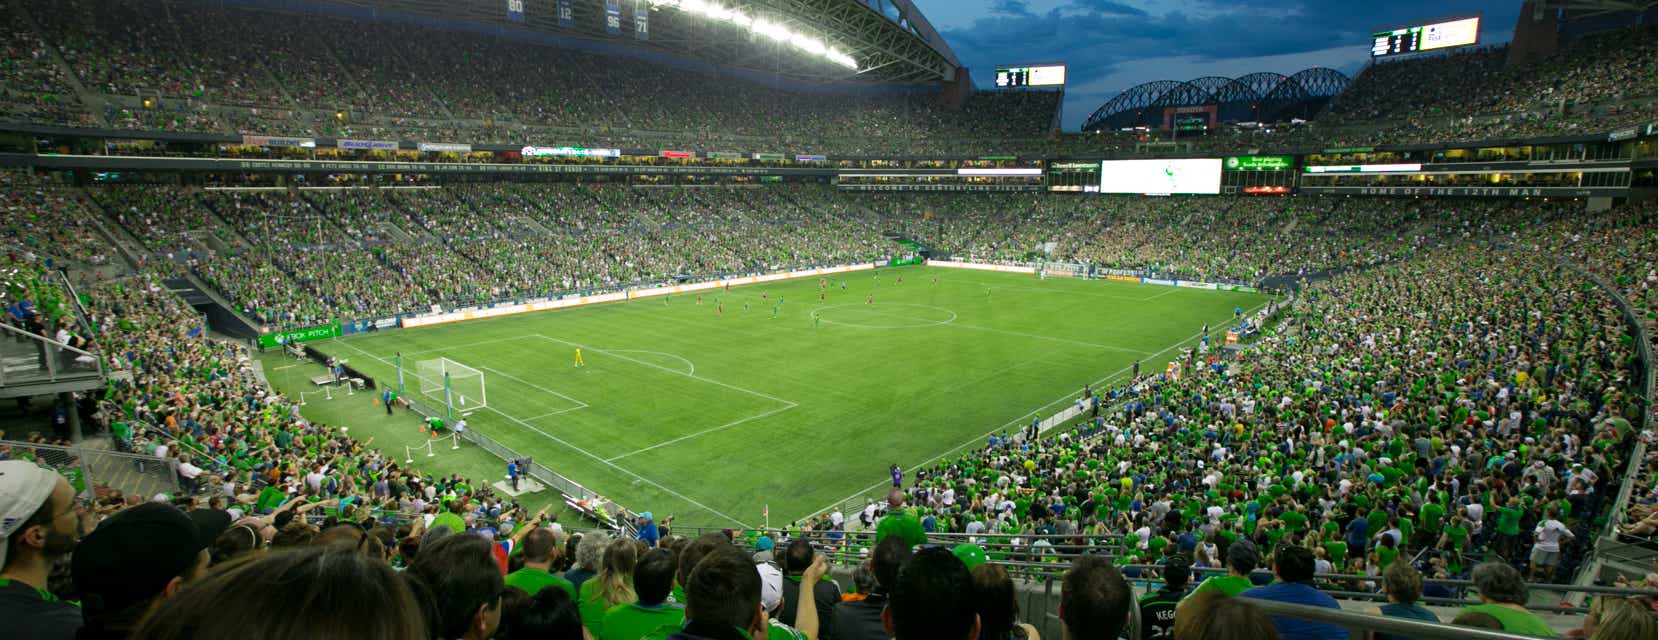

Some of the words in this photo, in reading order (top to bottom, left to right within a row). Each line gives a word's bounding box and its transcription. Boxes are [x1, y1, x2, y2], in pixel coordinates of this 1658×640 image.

[560, 7, 572, 20] 12
[607, 16, 620, 28] 96
[637, 21, 647, 33] 71
